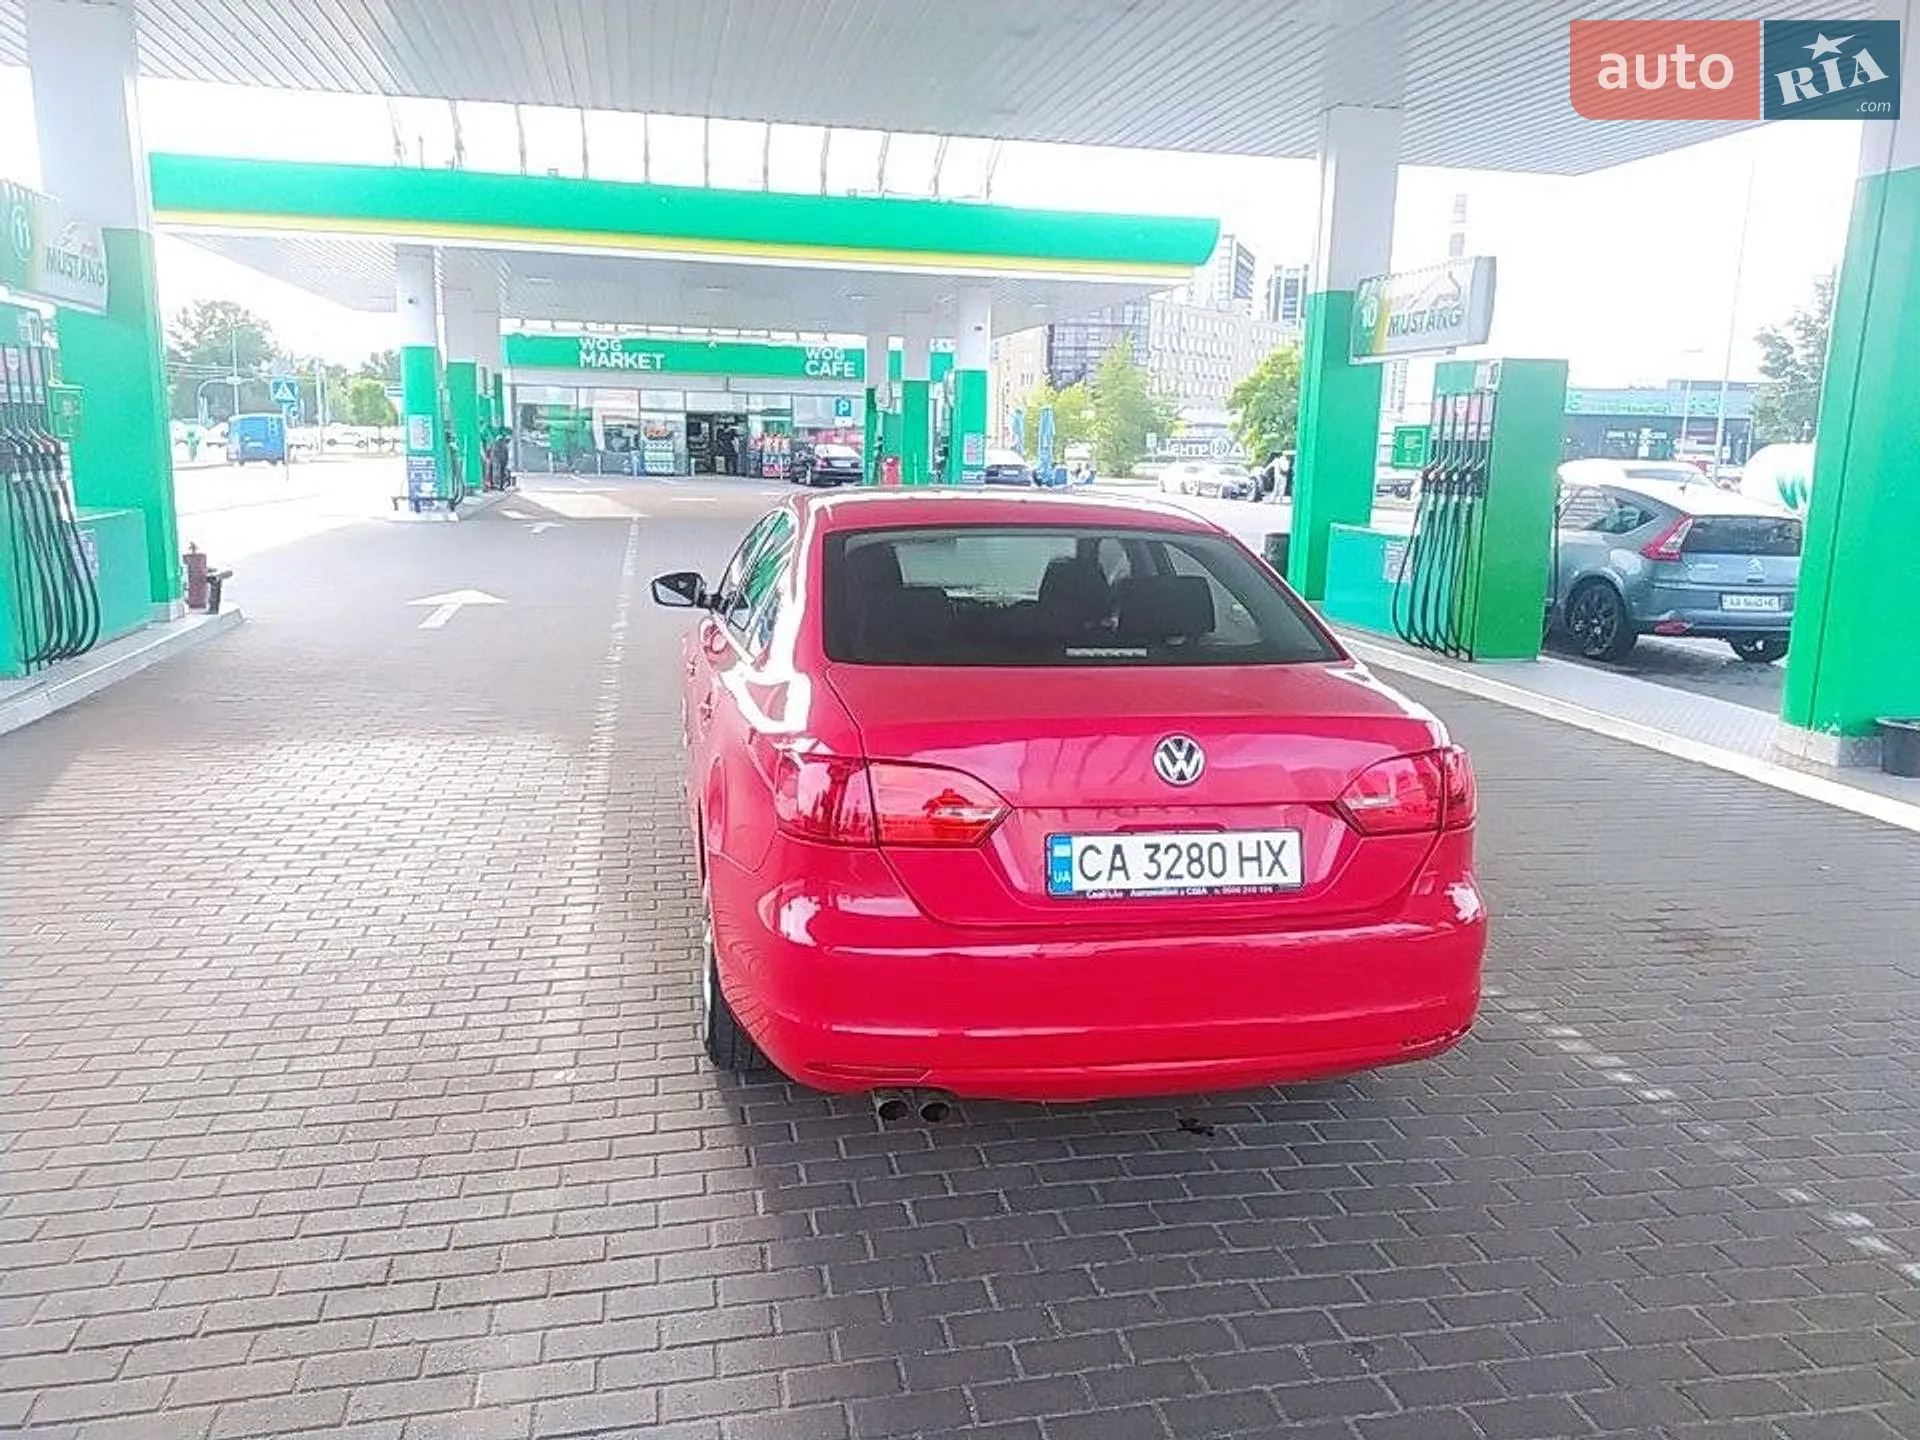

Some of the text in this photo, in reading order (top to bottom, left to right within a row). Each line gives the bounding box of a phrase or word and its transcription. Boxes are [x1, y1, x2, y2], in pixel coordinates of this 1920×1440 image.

[43, 246, 106, 287] MUSTANG
[1388, 303, 1464, 337] MUSTANG
[579, 338, 622, 351] WOG
[579, 351, 665, 369] MARKET
[805, 347, 846, 361] WOG
[805, 361, 857, 378] CAFE
[1079, 840, 1288, 882] CA 3280 HX
[1053, 870, 1072, 884] UA
